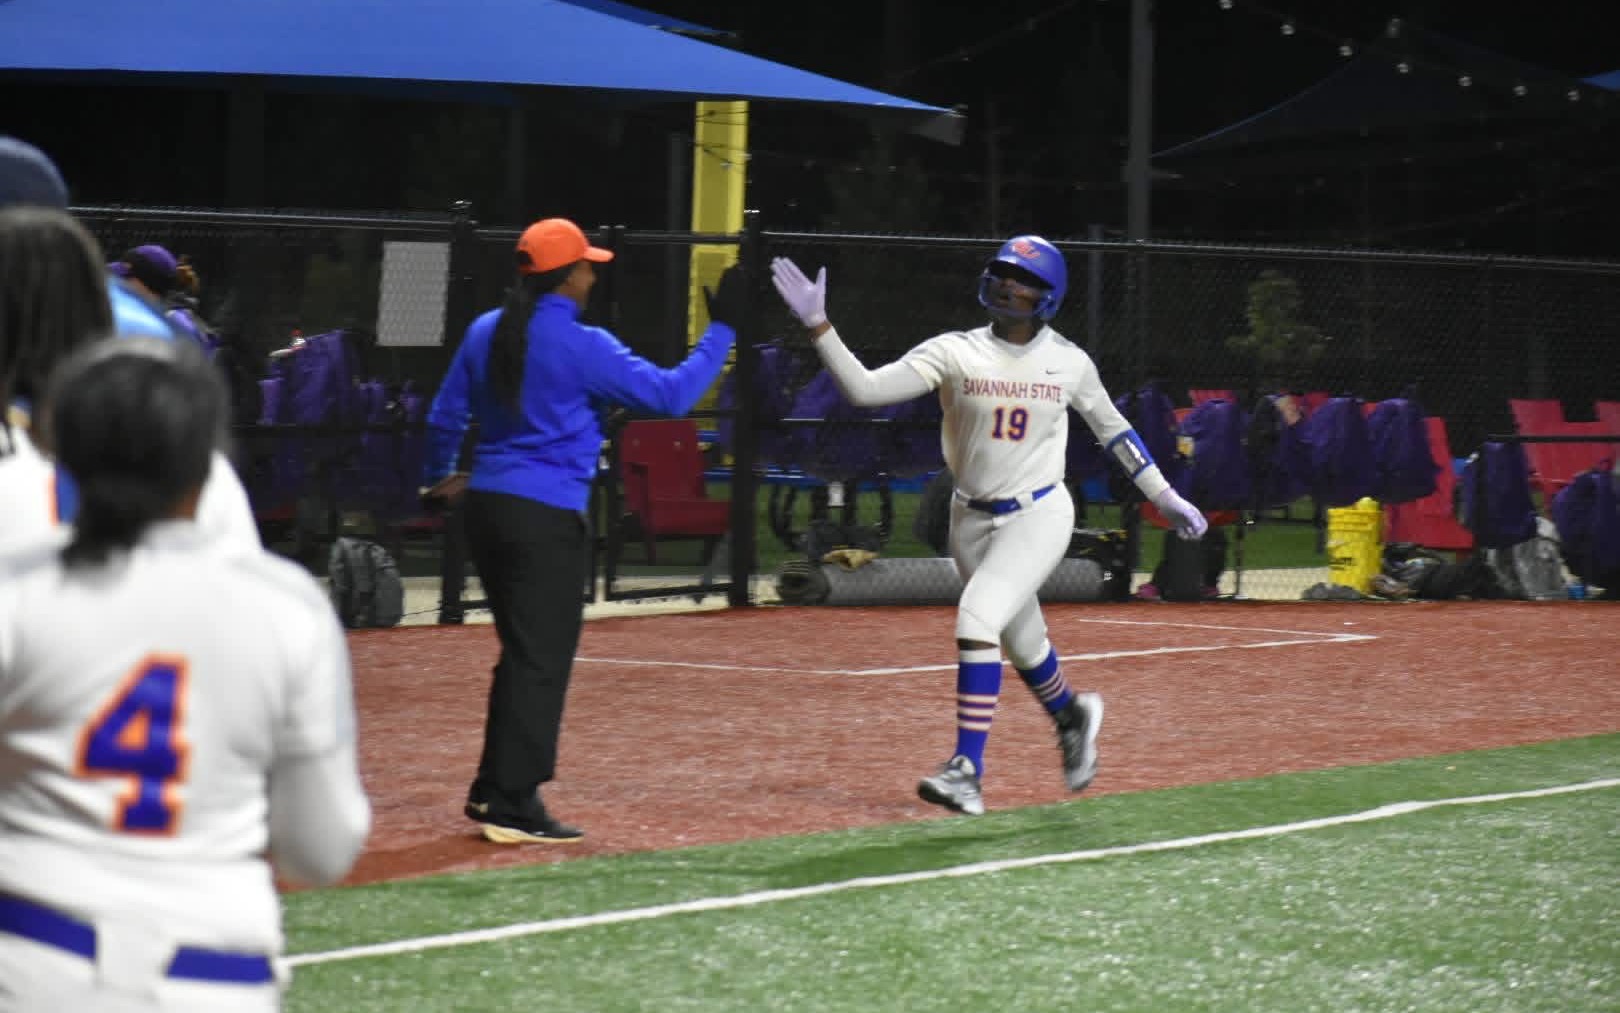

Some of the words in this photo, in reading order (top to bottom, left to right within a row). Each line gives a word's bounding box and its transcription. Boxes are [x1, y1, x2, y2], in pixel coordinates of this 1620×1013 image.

[963, 377, 1028, 398] SAVANNAH
[1030, 383, 1062, 403] STATE
[991, 404, 1029, 442] 19
[73, 650, 190, 838] 4
